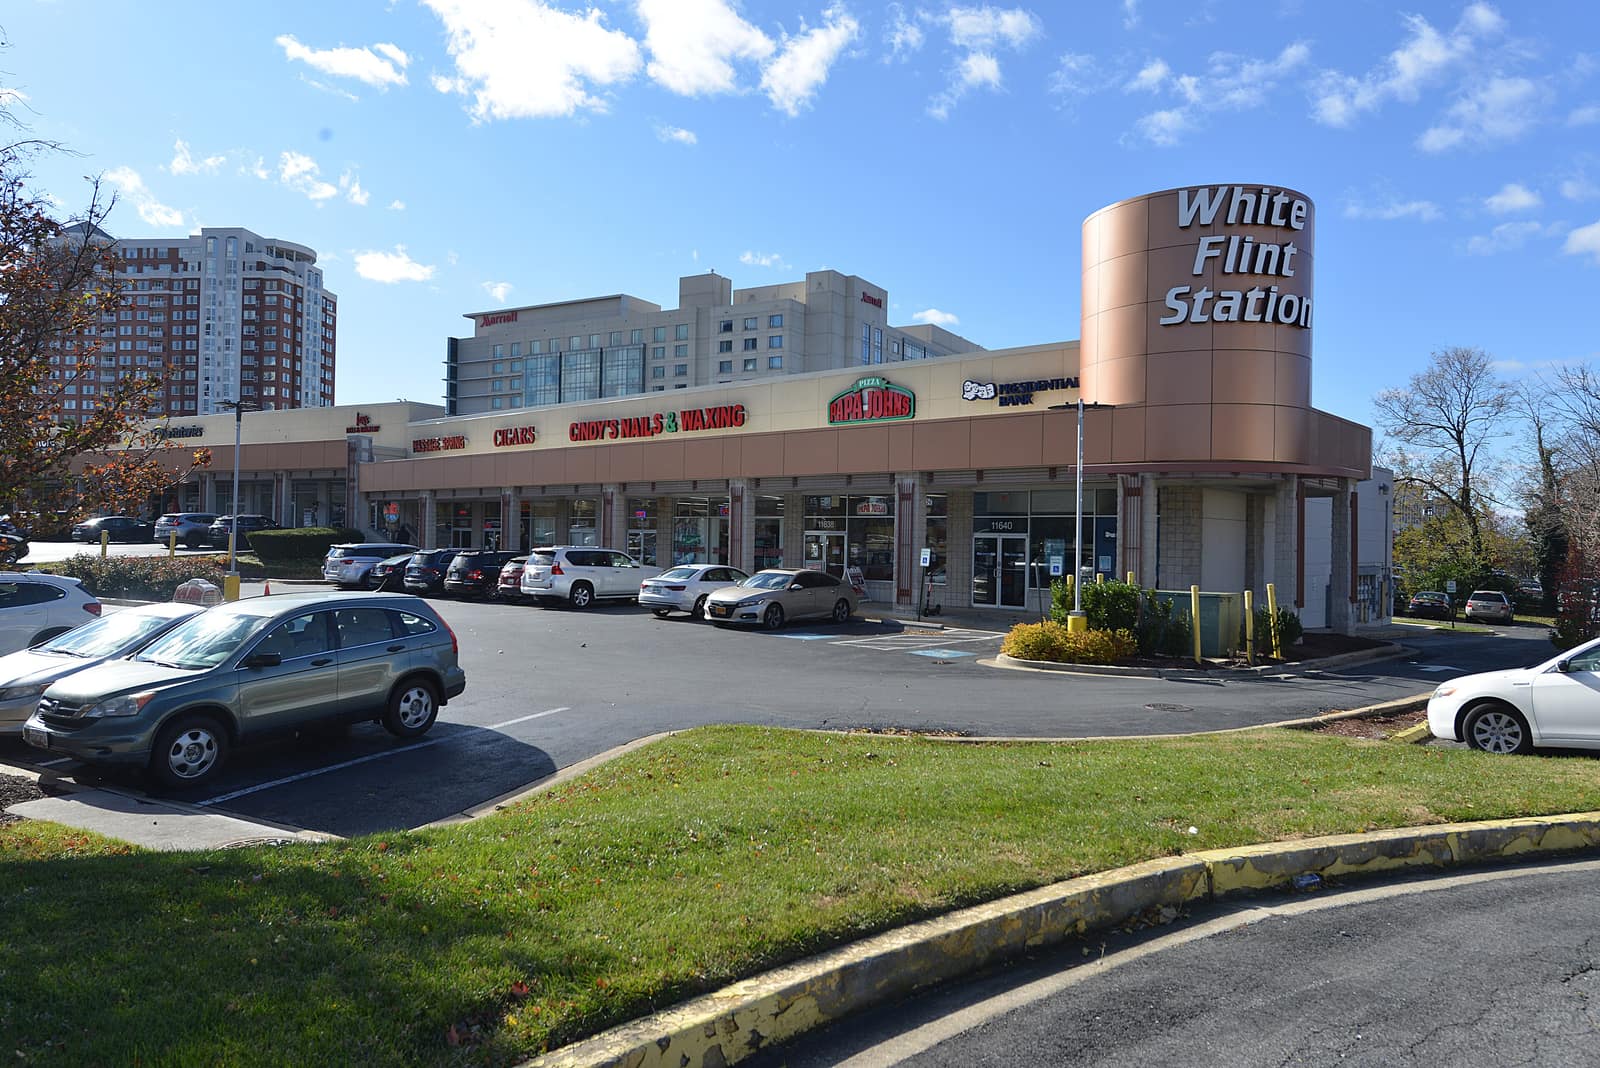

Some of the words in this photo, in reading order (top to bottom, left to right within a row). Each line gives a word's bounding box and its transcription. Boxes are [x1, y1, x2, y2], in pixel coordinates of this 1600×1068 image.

[1178, 186, 1308, 230] White
[1192, 235, 1297, 277] Flint
[480, 311, 518, 327] Marriott
[1160, 285, 1312, 328] Station
[859, 378, 881, 387] PIZZA
[829, 392, 863, 422] PAPA
[864, 391, 911, 419] JOHNS
[998, 394, 1034, 407] BANK
[569, 419, 618, 442] CINDY'S
[620, 413, 663, 438] NAILS
[665, 412, 678, 433] &
[680, 404, 746, 431] WAXING
[493, 426, 536, 447] CIGARS
[991, 521, 1013, 530] 11640
